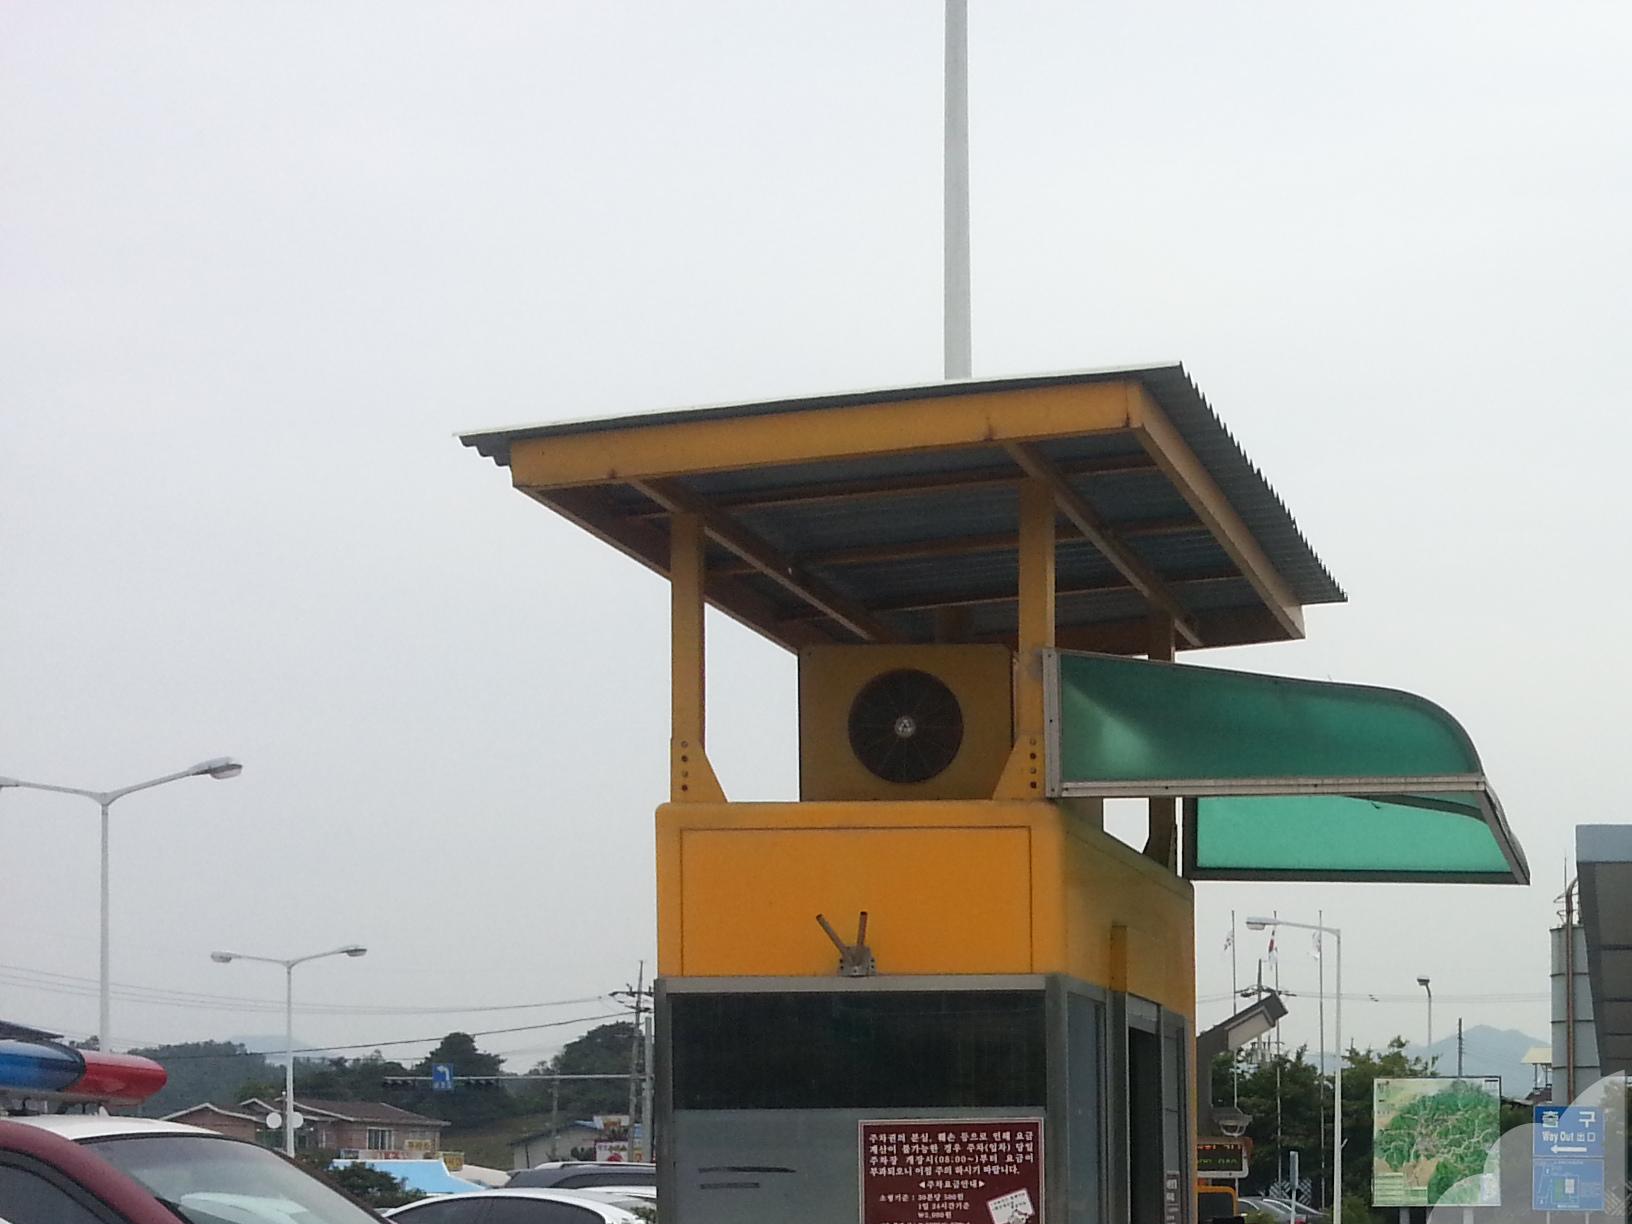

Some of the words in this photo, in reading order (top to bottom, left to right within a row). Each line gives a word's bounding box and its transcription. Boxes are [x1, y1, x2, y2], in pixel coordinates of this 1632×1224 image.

[1016, 1131, 1033, 1141] 요금
[1542, 1130, 1559, 1143] Way
[1560, 1130, 1574, 1142] Out
[944, 1143, 961, 1153] 경우
